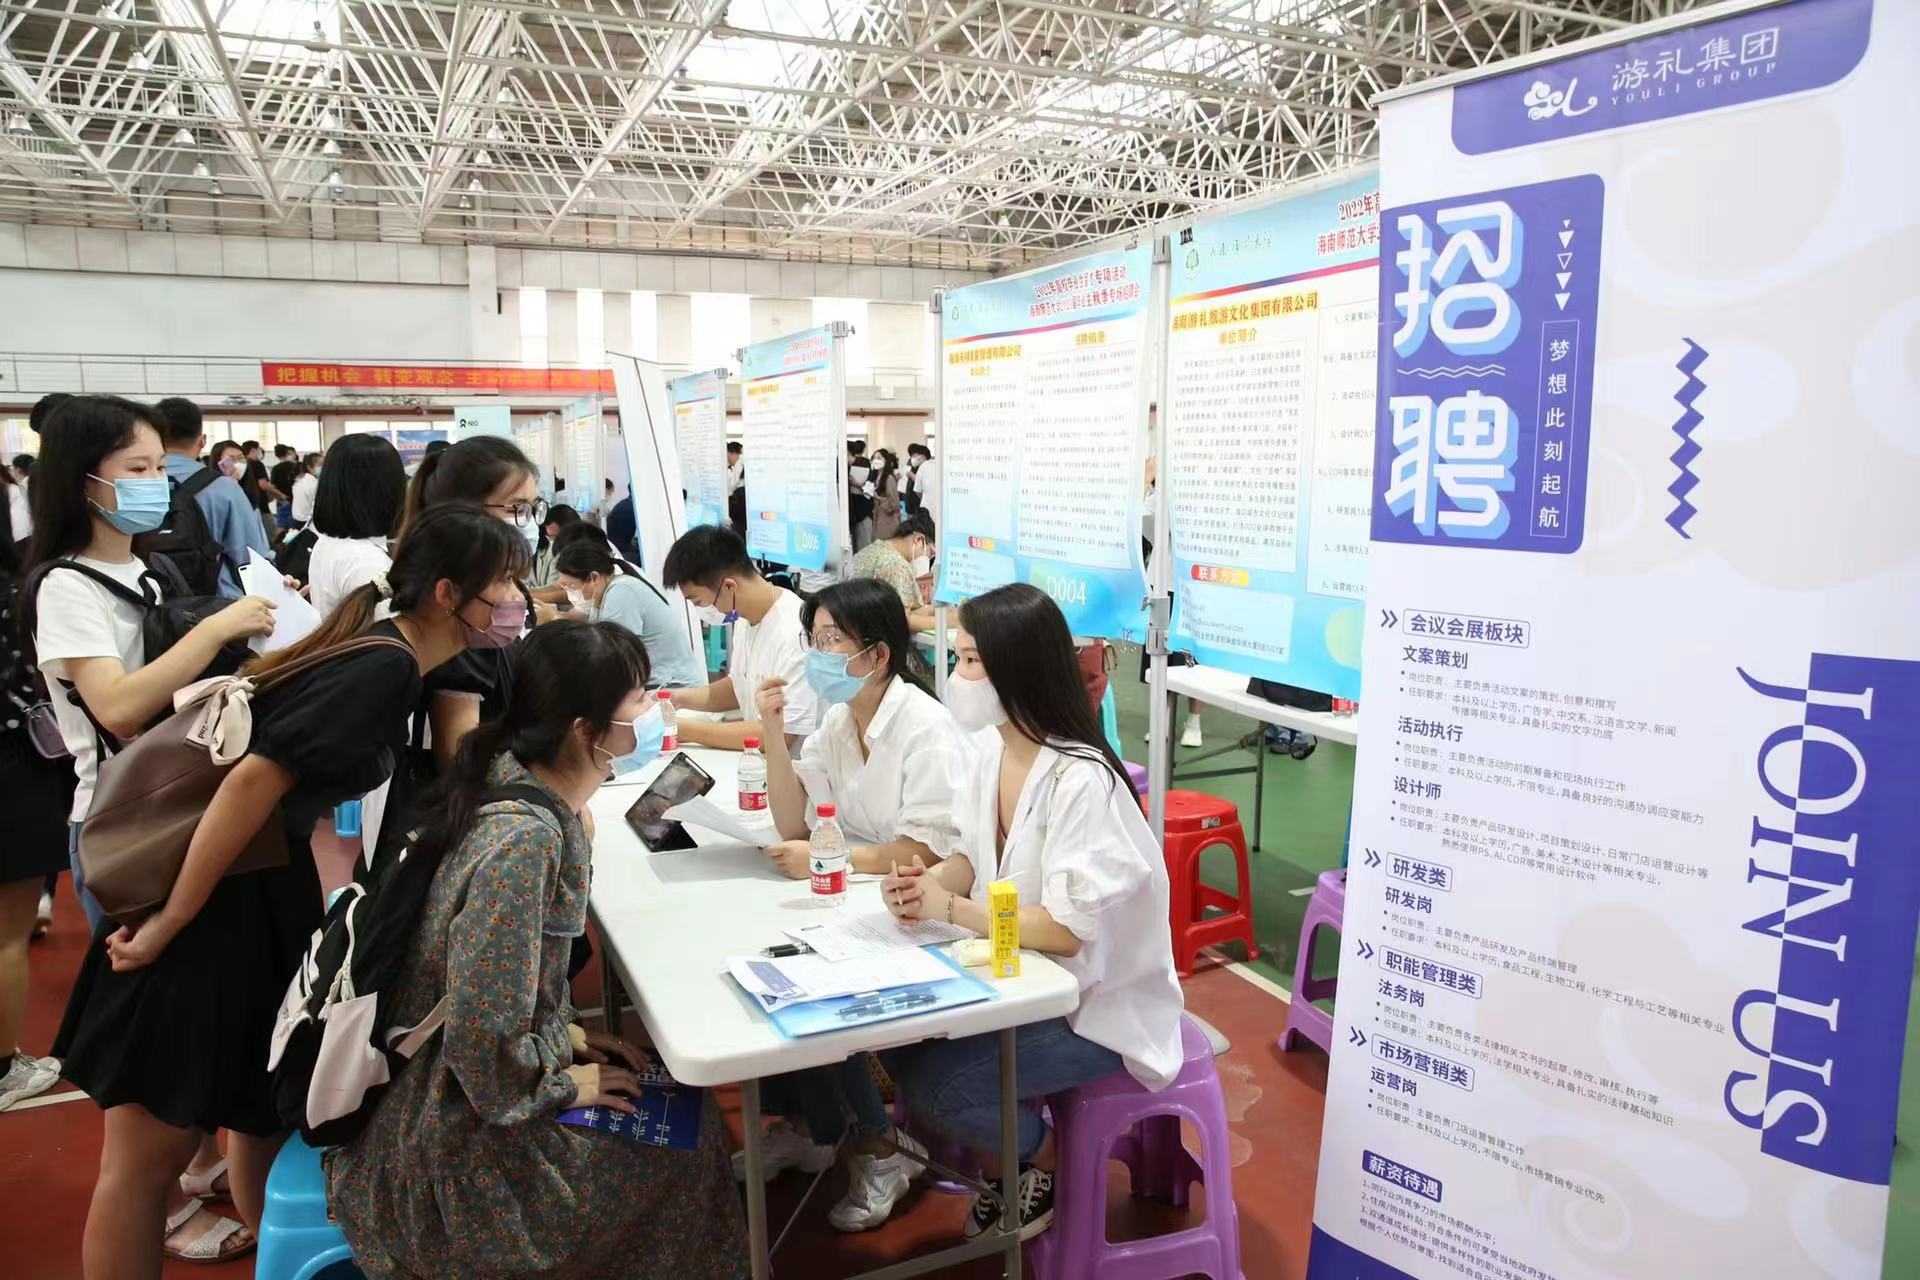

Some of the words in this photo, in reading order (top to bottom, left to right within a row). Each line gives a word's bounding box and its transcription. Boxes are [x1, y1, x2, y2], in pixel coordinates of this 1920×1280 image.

[1611, 27, 1780, 91] 游礼集团
[1611, 82, 1681, 106] YOULI
[1696, 61, 1777, 89] GROUP
[277, 367, 361, 384] 把握机会
[374, 369, 454, 385] 转变观念
[1384, 200, 1524, 540] 招聘
[1537, 338, 1571, 528] 梦想此刻起航
[1045, 575, 1087, 606] D004
[1410, 613, 1525, 645] 会议会展板块
[1402, 645, 1469, 670] 文案策划
[1398, 715, 1464, 743] 活动执行
[1393, 775, 1442, 800] 设计师
[1736, 666, 1875, 963] JOIN
[1392, 857, 1448, 888] 研发类
[1384, 886, 1433, 914] 研发岗
[1385, 951, 1477, 995] 职能管理类
[1377, 978, 1425, 1008] 法务岗
[1378, 1041, 1469, 1087] 市场营销类
[1723, 988, 1841, 1148] US
[1370, 1066, 1418, 1097] 运营岗
[1368, 1155, 1440, 1201] 薪资待遇
